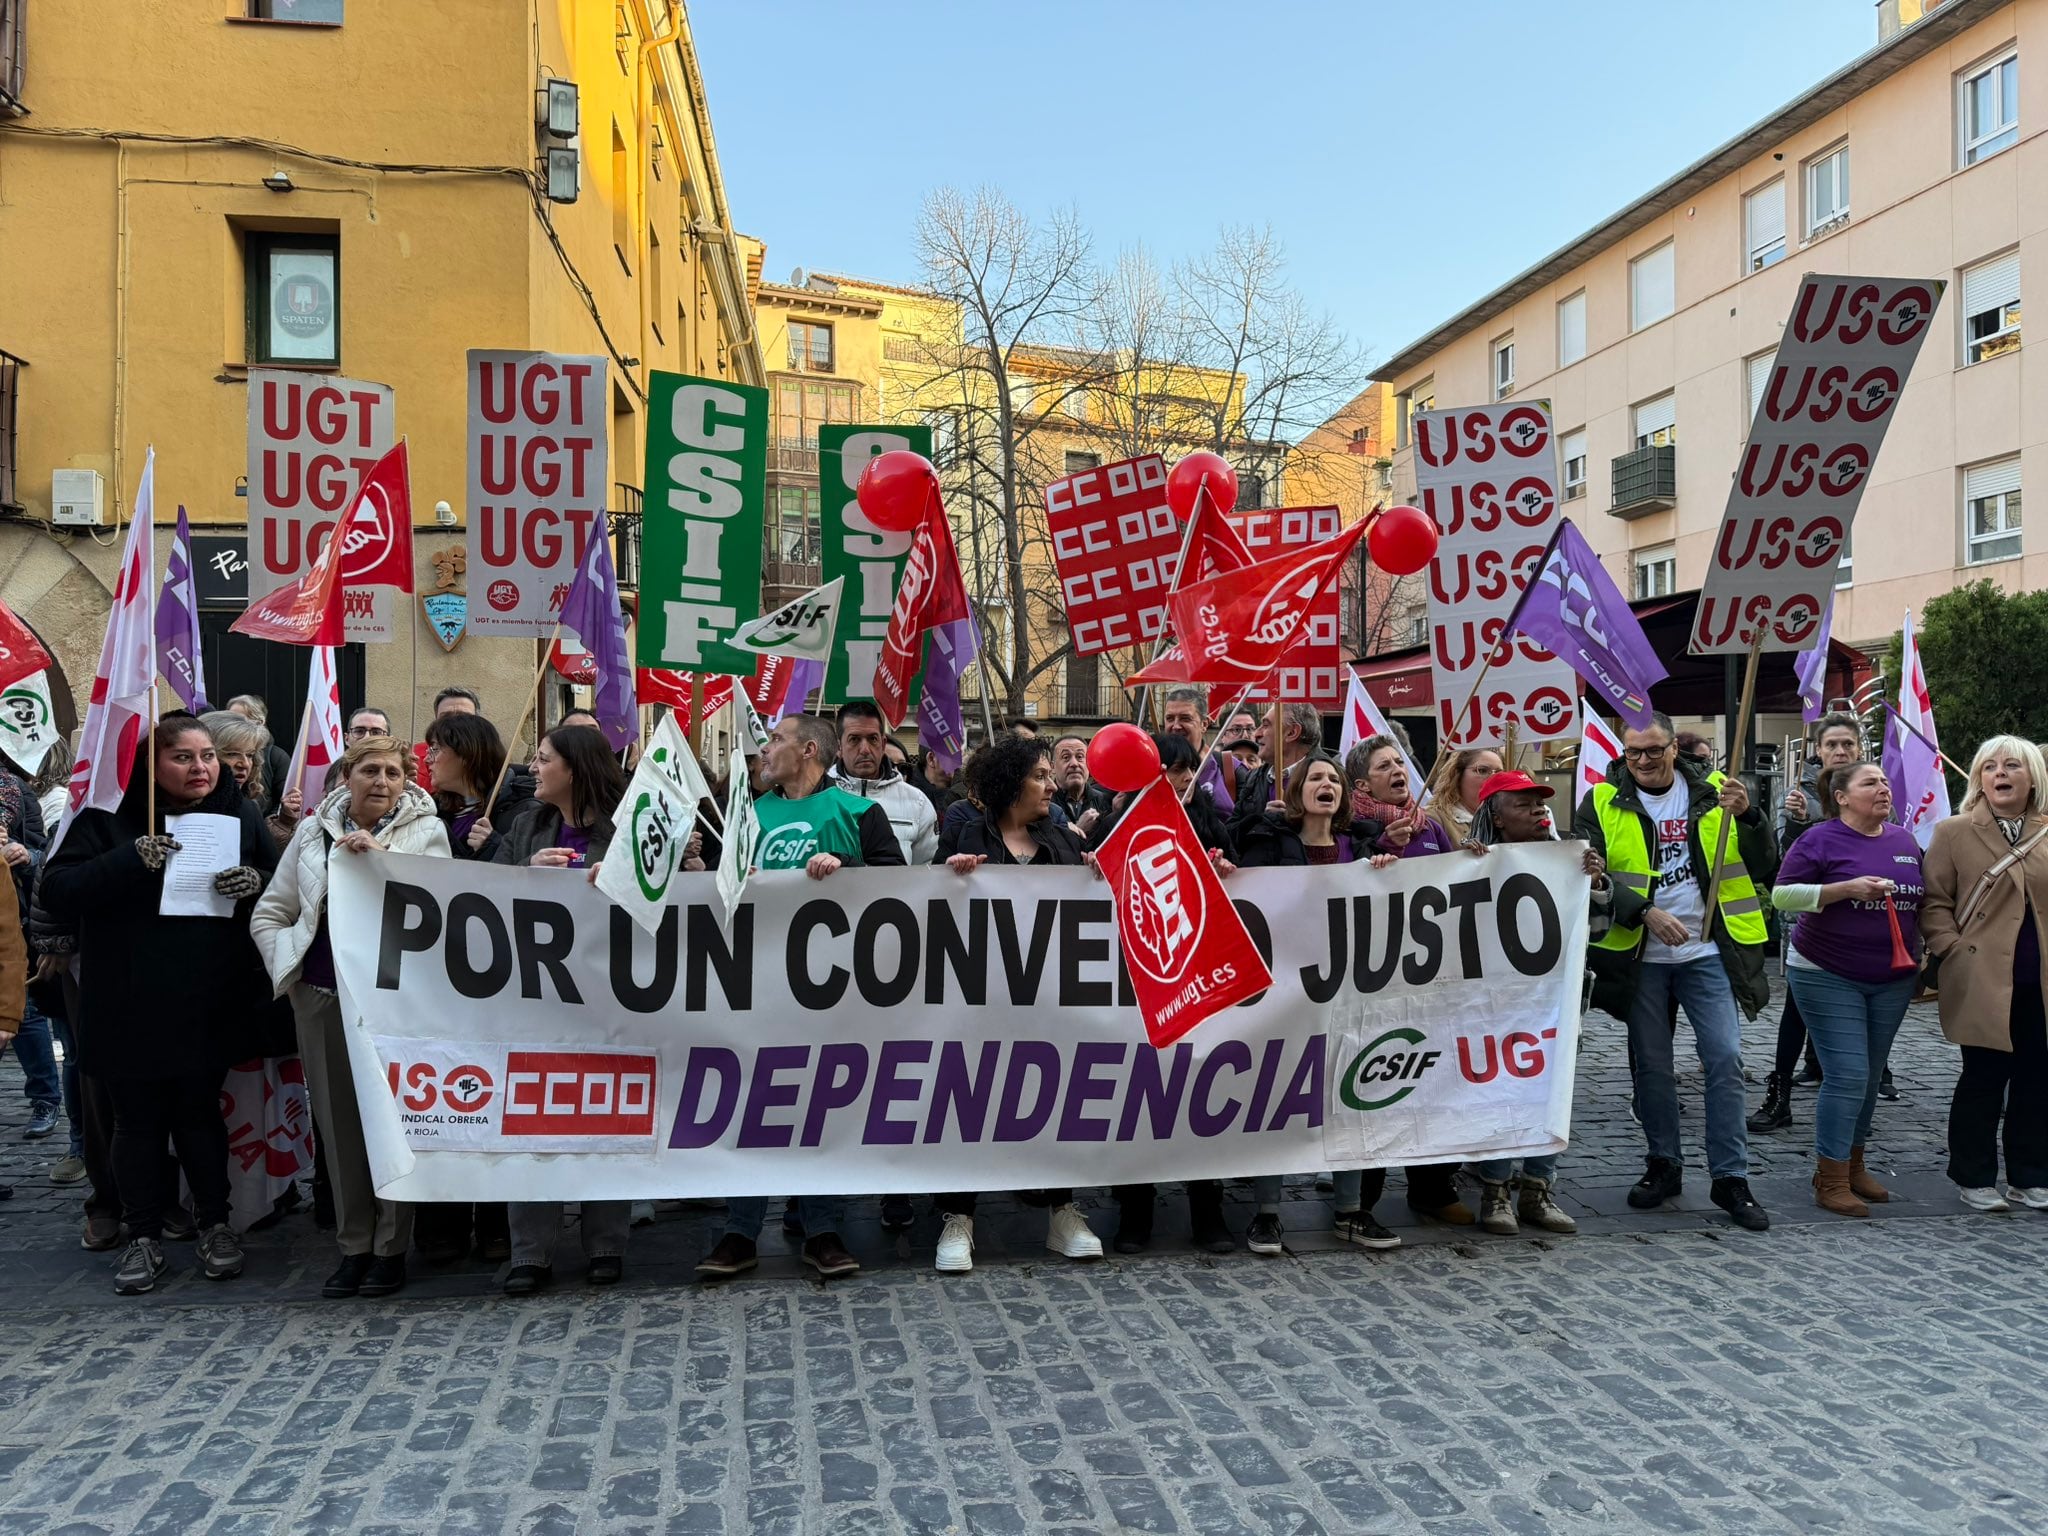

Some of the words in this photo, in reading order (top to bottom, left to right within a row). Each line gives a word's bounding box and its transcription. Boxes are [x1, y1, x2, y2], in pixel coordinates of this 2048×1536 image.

[281, 315, 325, 325] SPATEN
[1794, 283, 1932, 346] USO
[263, 380, 381, 448] UGT
[480, 361, 592, 426] UGT
[1765, 365, 1899, 423] USO
[480, 434, 593, 498] UGT
[1416, 407, 1548, 468] USO
[1739, 443, 1869, 498] USO
[1423, 476, 1555, 537] USO
[480, 506, 594, 569] UGT
[1718, 516, 1843, 571] USO
[1699, 593, 1820, 647] USO
[1439, 686, 1574, 745] USO
[765, 838, 818, 862] CSIF
[1850, 899, 1861, 909] Y
[375, 879, 586, 1006] POR
[609, 902, 755, 1014] UN
[1299, 872, 1563, 1004] JUSTO
[1155, 961, 1237, 1027] www.ugt.es
[505, 1071, 651, 1116] CCOO
[666, 1032, 1326, 1150] DEPENDENCIA
[1359, 1051, 1442, 1085] CSIF
[399, 1114, 445, 1125] INDICAL
[447, 1115, 489, 1126] OBRERA
[413, 1128, 440, 1137] RIOJA
